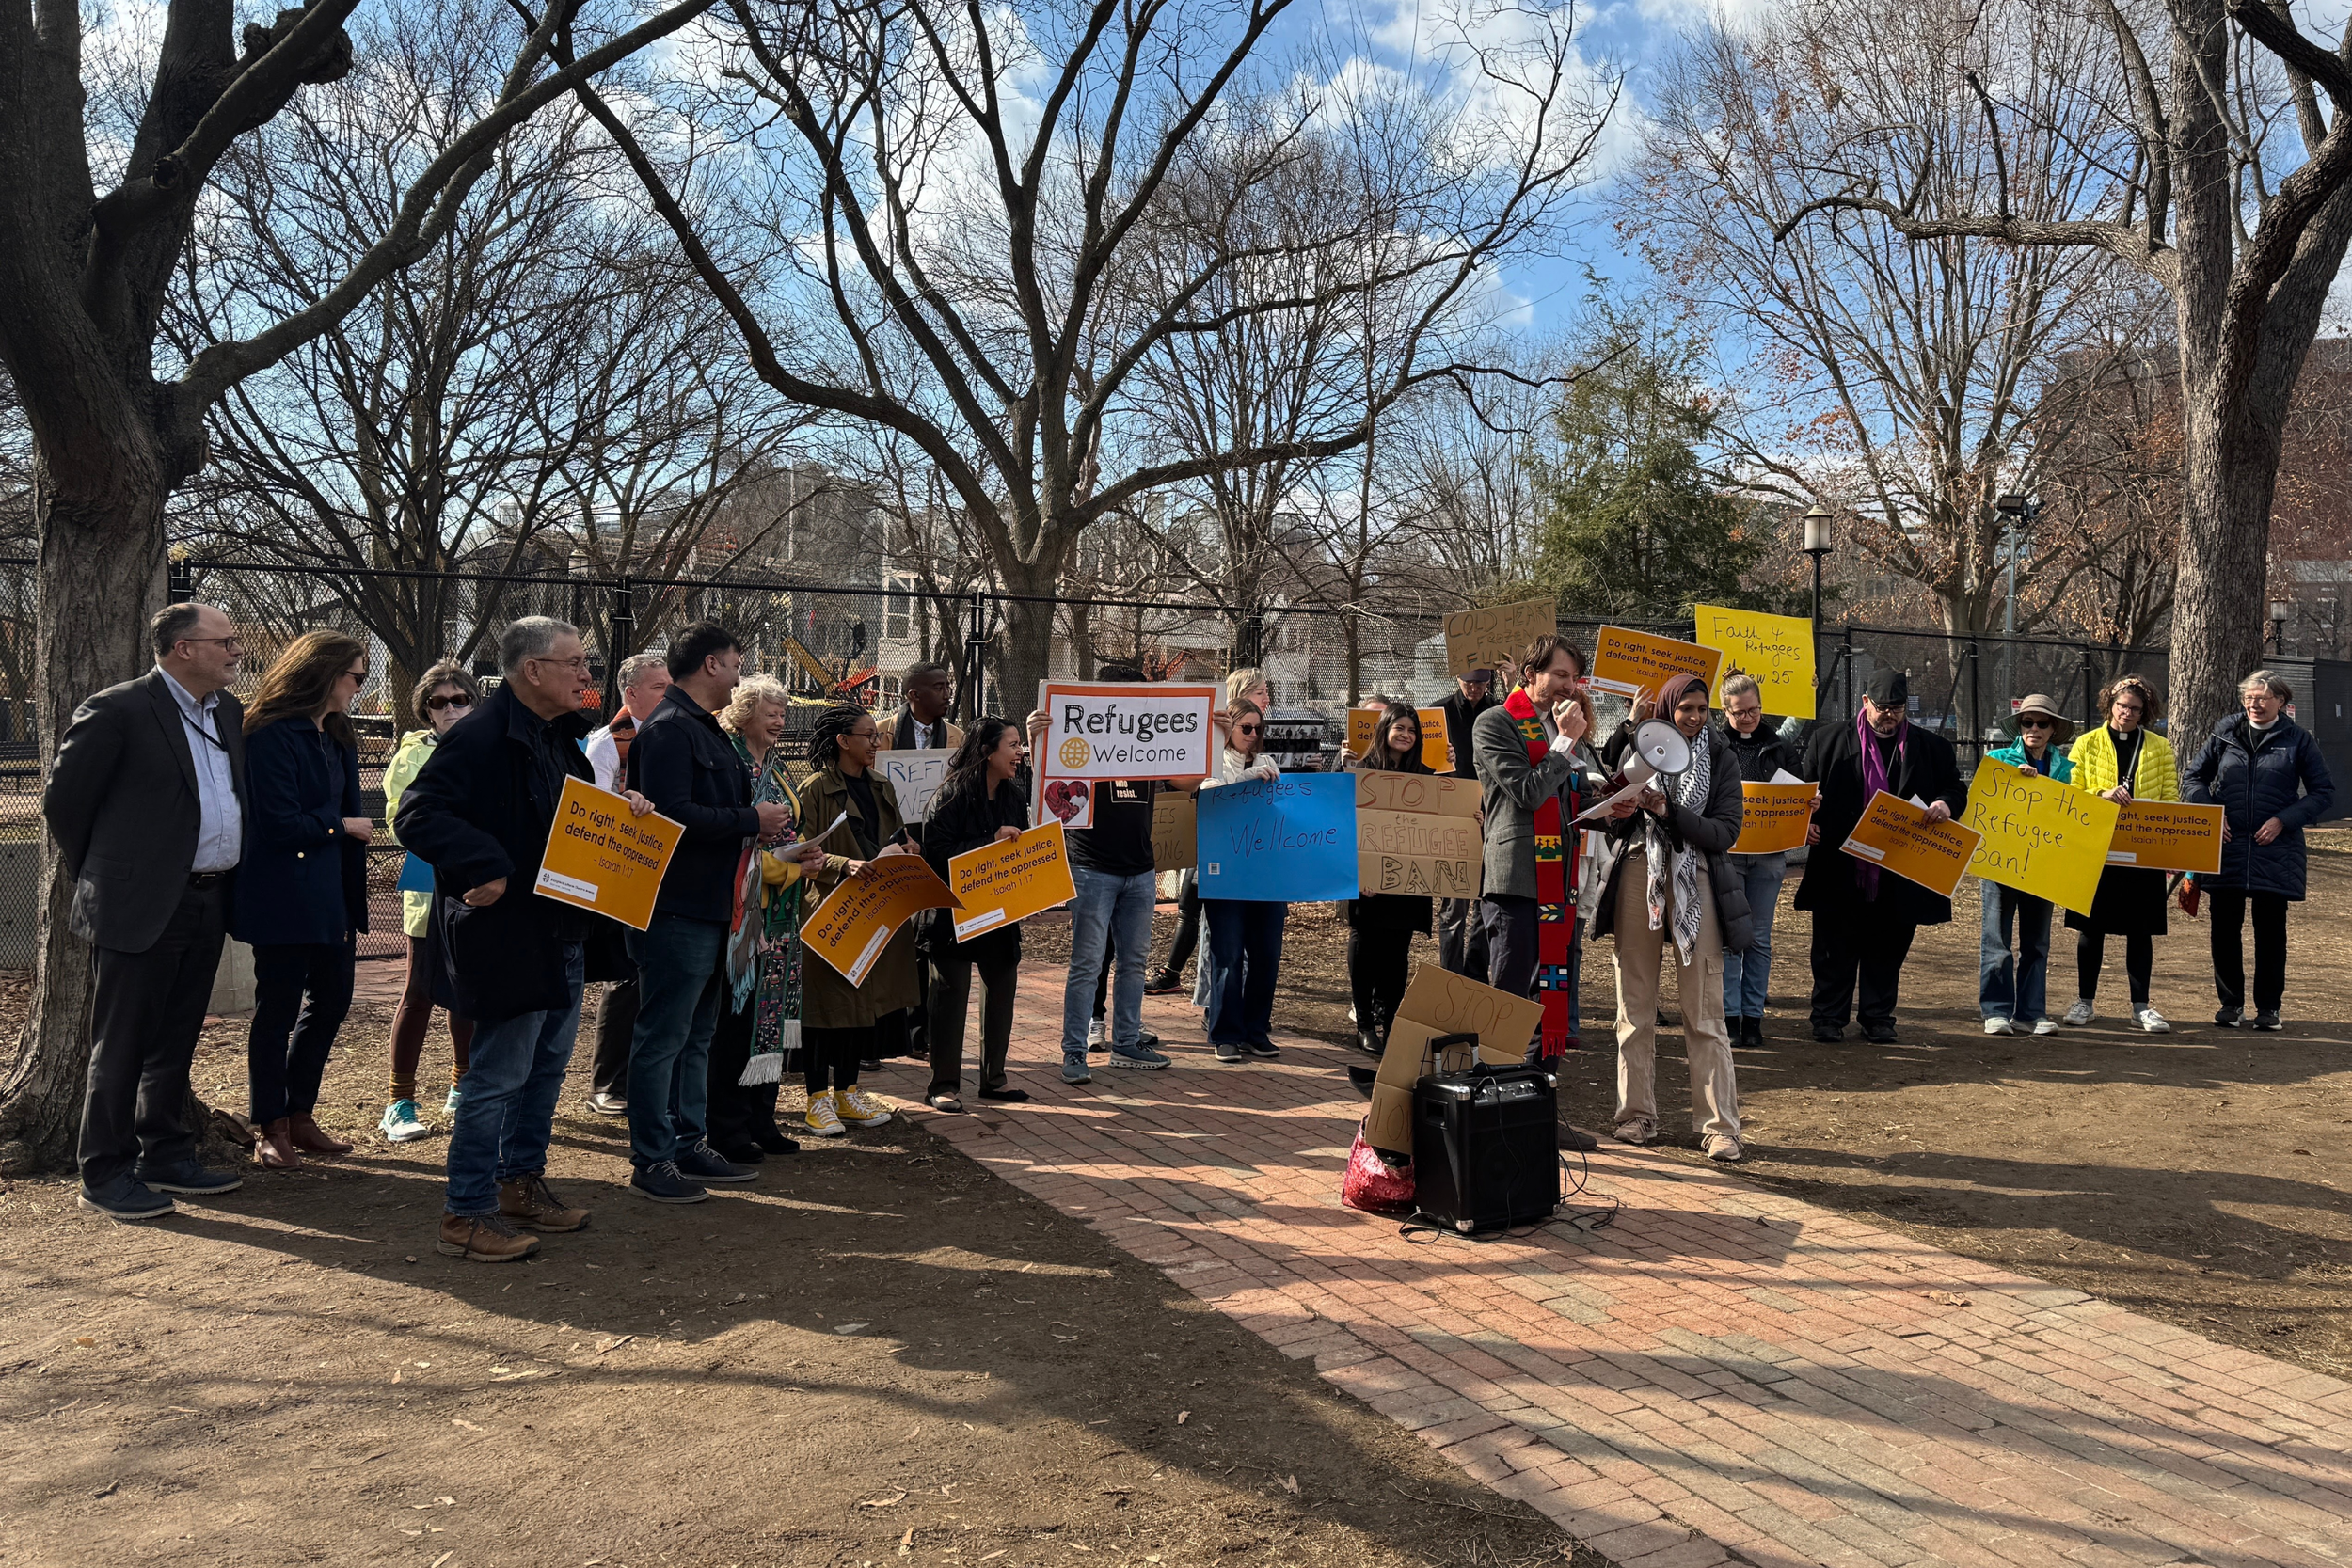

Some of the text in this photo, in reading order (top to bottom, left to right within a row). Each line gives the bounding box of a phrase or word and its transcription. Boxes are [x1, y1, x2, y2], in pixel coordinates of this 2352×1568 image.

[1449, 602, 1553, 638] COLD HEART
[1713, 617, 1761, 640] Faith
[1477, 626, 1534, 649] FROZEN
[1605, 650, 1707, 678] defend the oppressed
[1607, 638, 1708, 668] Do right, seek justice,
[1745, 640, 1801, 668] Refugees
[1637, 668, 1658, 679] Isaiah
[1772, 670, 1794, 685] 25
[1063, 704, 1198, 743] Refugees
[1357, 721, 1370, 729] Do
[1422, 730, 1443, 739] ressed
[1093, 744, 1187, 763] Welcome
[1116, 788, 1138, 798] resist.
[1212, 782, 1312, 805] Refugees
[1356, 772, 1456, 811] STOP
[1743, 796, 1769, 804] seek
[1981, 768, 2090, 826] Stop the
[570, 800, 664, 854] Do right, seek justice,
[1395, 814, 1419, 825] the
[1754, 807, 1805, 818] oppressed
[1876, 804, 1964, 849] Do right, seek justice,
[1972, 802, 2066, 848] Refugee
[2143, 813, 2169, 823] seek
[2173, 815, 2212, 827] justice,
[1359, 822, 1468, 856] REFUGEE
[1870, 816, 1961, 860] defend the oppressed
[2131, 835, 2157, 845] Isaiah
[2160, 837, 2178, 847] 1:17
[2136, 824, 2153, 833] the
[2154, 826, 2211, 837] oppressed
[564, 822, 660, 870] defend the oppressed
[960, 839, 1056, 880] Do right, seek justice,
[1889, 835, 1909, 849] Isaiah
[1910, 845, 1927, 856] 1:17
[1971, 837, 2030, 879] Ban!
[598, 855, 621, 873] Isaiah
[622, 863, 634, 879] 1:17
[961, 850, 1057, 894] defend the oppressed
[1380, 856, 1471, 894] BAN
[866, 895, 893, 920] Isaiah
[892, 884, 911, 895] 1:17
[993, 881, 1017, 895] Isaiah
[817, 922, 833, 940] Do
[832, 895, 858, 922] right,
[858, 871, 886, 894] seek
[830, 873, 932, 948] defend the oppressed
[1434, 976, 1513, 1035] STOP
[1420, 1037, 1477, 1076] HAT
